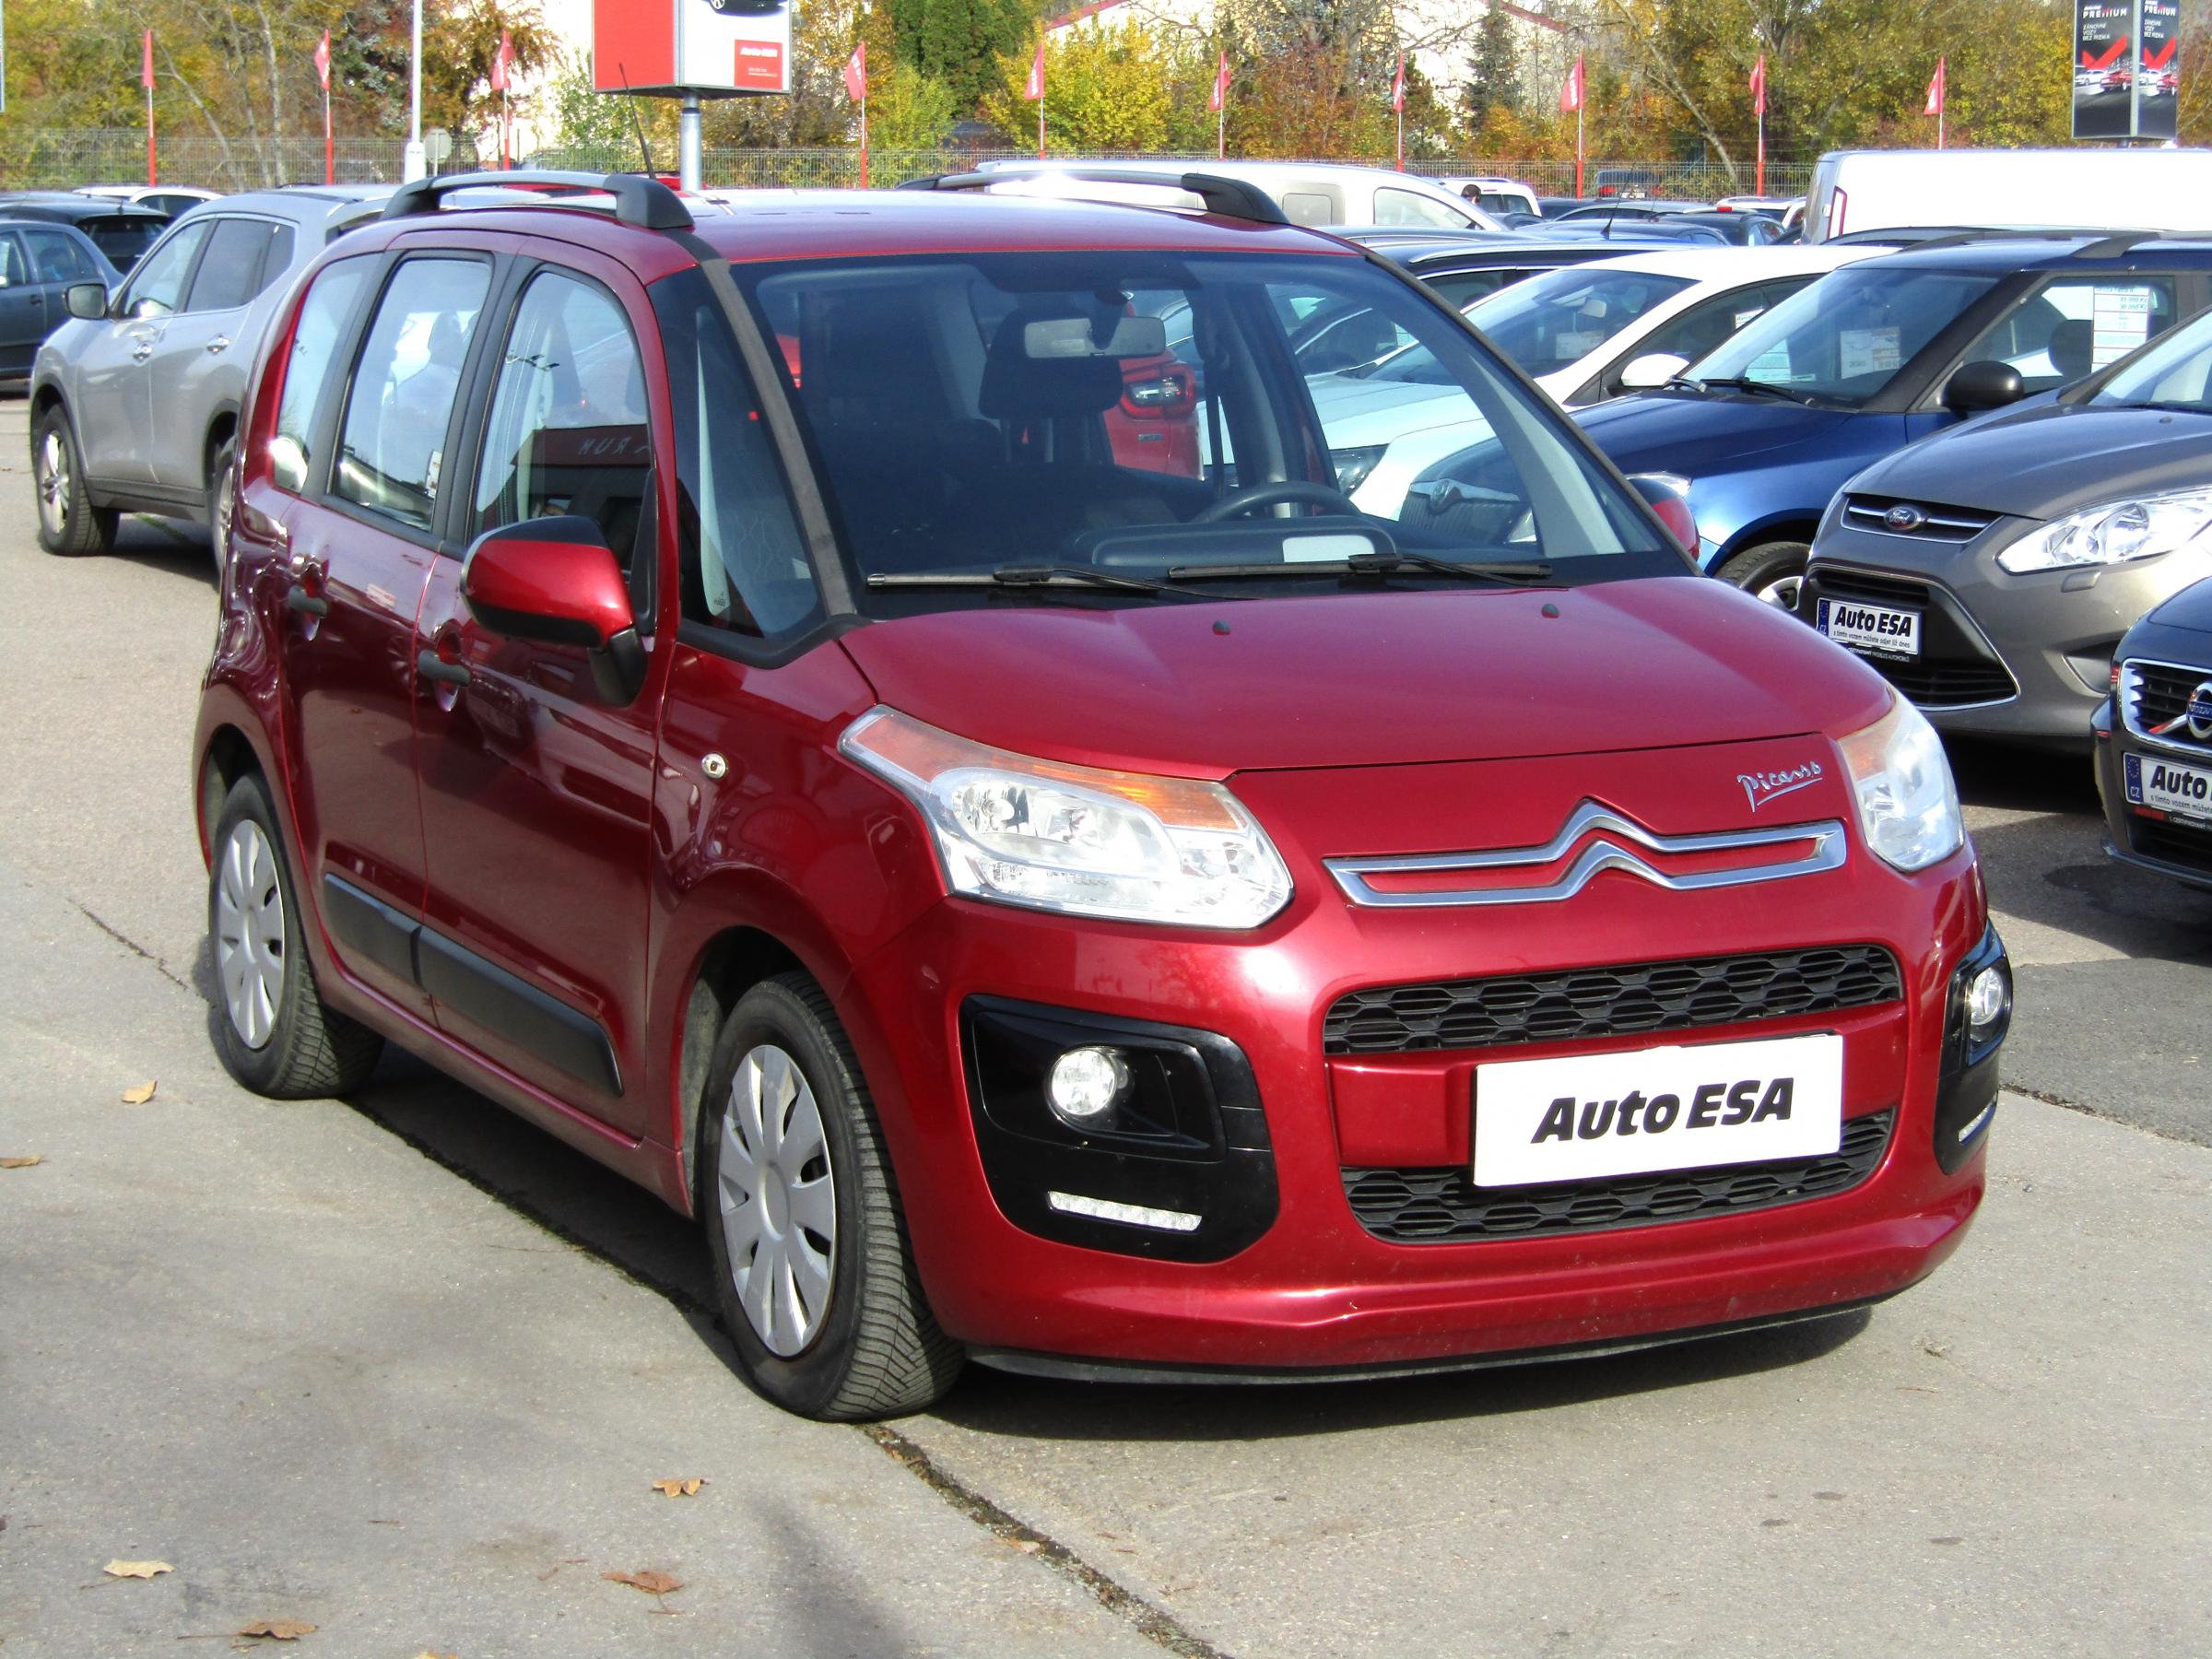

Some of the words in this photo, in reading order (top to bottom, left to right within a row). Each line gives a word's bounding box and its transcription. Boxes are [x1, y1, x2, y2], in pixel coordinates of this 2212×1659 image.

[2083, 7, 2127, 18] PREMIUM
[1834, 606, 1876, 631] Auto
[1877, 613, 1912, 637] ESA
[1736, 760, 1823, 813] Picasso
[2130, 786, 2140, 798] CZ
[2149, 766, 2206, 799] Auto
[1530, 1089, 1680, 1144] Auto
[1686, 1077, 1794, 1129] ESA
